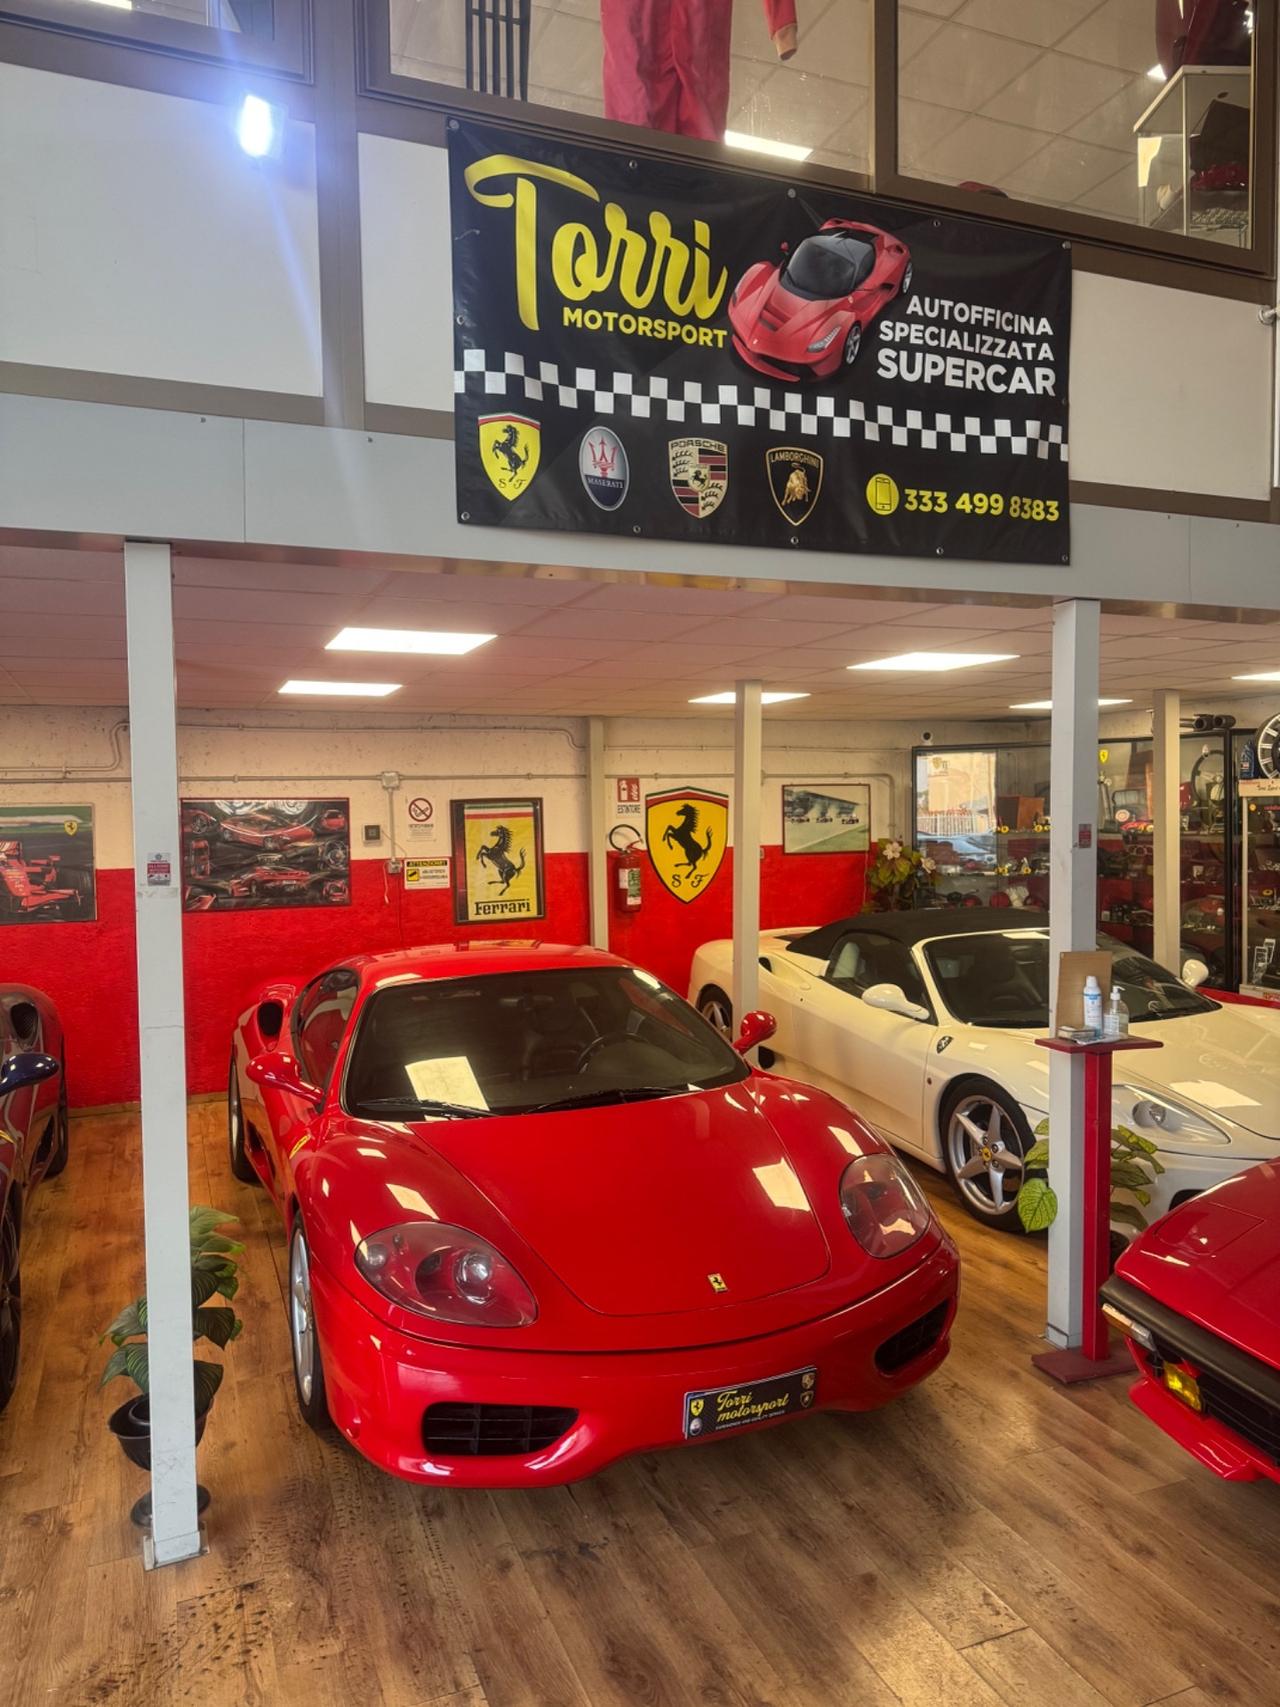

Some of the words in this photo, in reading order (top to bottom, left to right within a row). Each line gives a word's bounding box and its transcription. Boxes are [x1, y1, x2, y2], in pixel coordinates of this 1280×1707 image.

[464, 154, 728, 330] Torri
[563, 306, 727, 348] MOTORSPORT
[906, 295, 1053, 336] AUTOFFICINA
[879, 320, 1054, 361] SPECIALIZZATA
[877, 348, 1056, 396] SUPERCAR
[670, 438, 726, 451] PORSCHE
[769, 451, 819, 468] LAMBORGHINI
[587, 477, 624, 489] MASERATI
[904, 488, 948, 513] 333
[955, 492, 1004, 515] 499
[1009, 496, 1060, 521] 8383
[671, 874, 682, 888] S
[474, 898, 531, 916] Ferrari
[716, 1393, 789, 1422] motorsport
[717, 1390, 753, 1411] Torri
